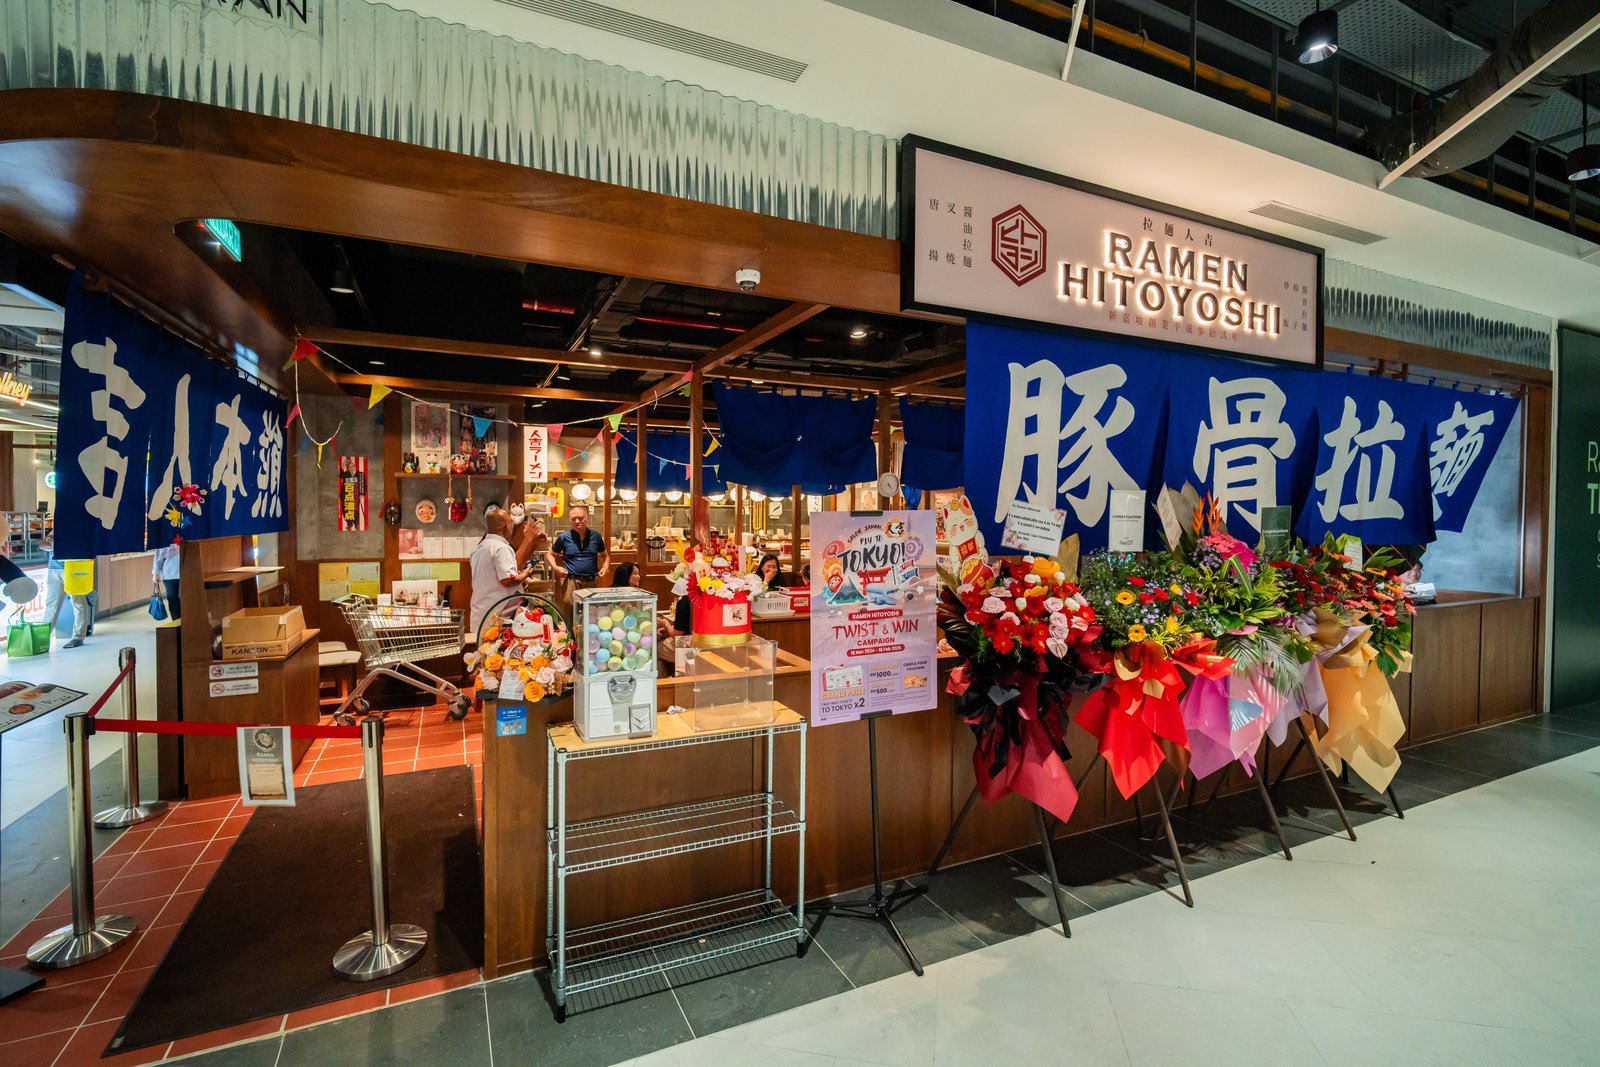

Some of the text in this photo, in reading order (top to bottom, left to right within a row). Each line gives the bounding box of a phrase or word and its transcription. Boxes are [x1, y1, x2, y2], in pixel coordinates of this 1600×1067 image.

[1109, 232, 1249, 292] RAMEN
[1059, 264, 1281, 335] HITOYOSHI
[528, 430, 543, 479] 人吉ラーメン
[1588, 441, 1600, 473] R
[1587, 483, 1600, 515] T
[836, 542, 906, 573] TOKYO!
[831, 619, 920, 640] TWIST & WIN
[851, 610, 900, 620] RAMEN HITOYOSHI
[857, 637, 896, 647] CAMPAIGN
[831, 704, 853, 712] TOKYO
